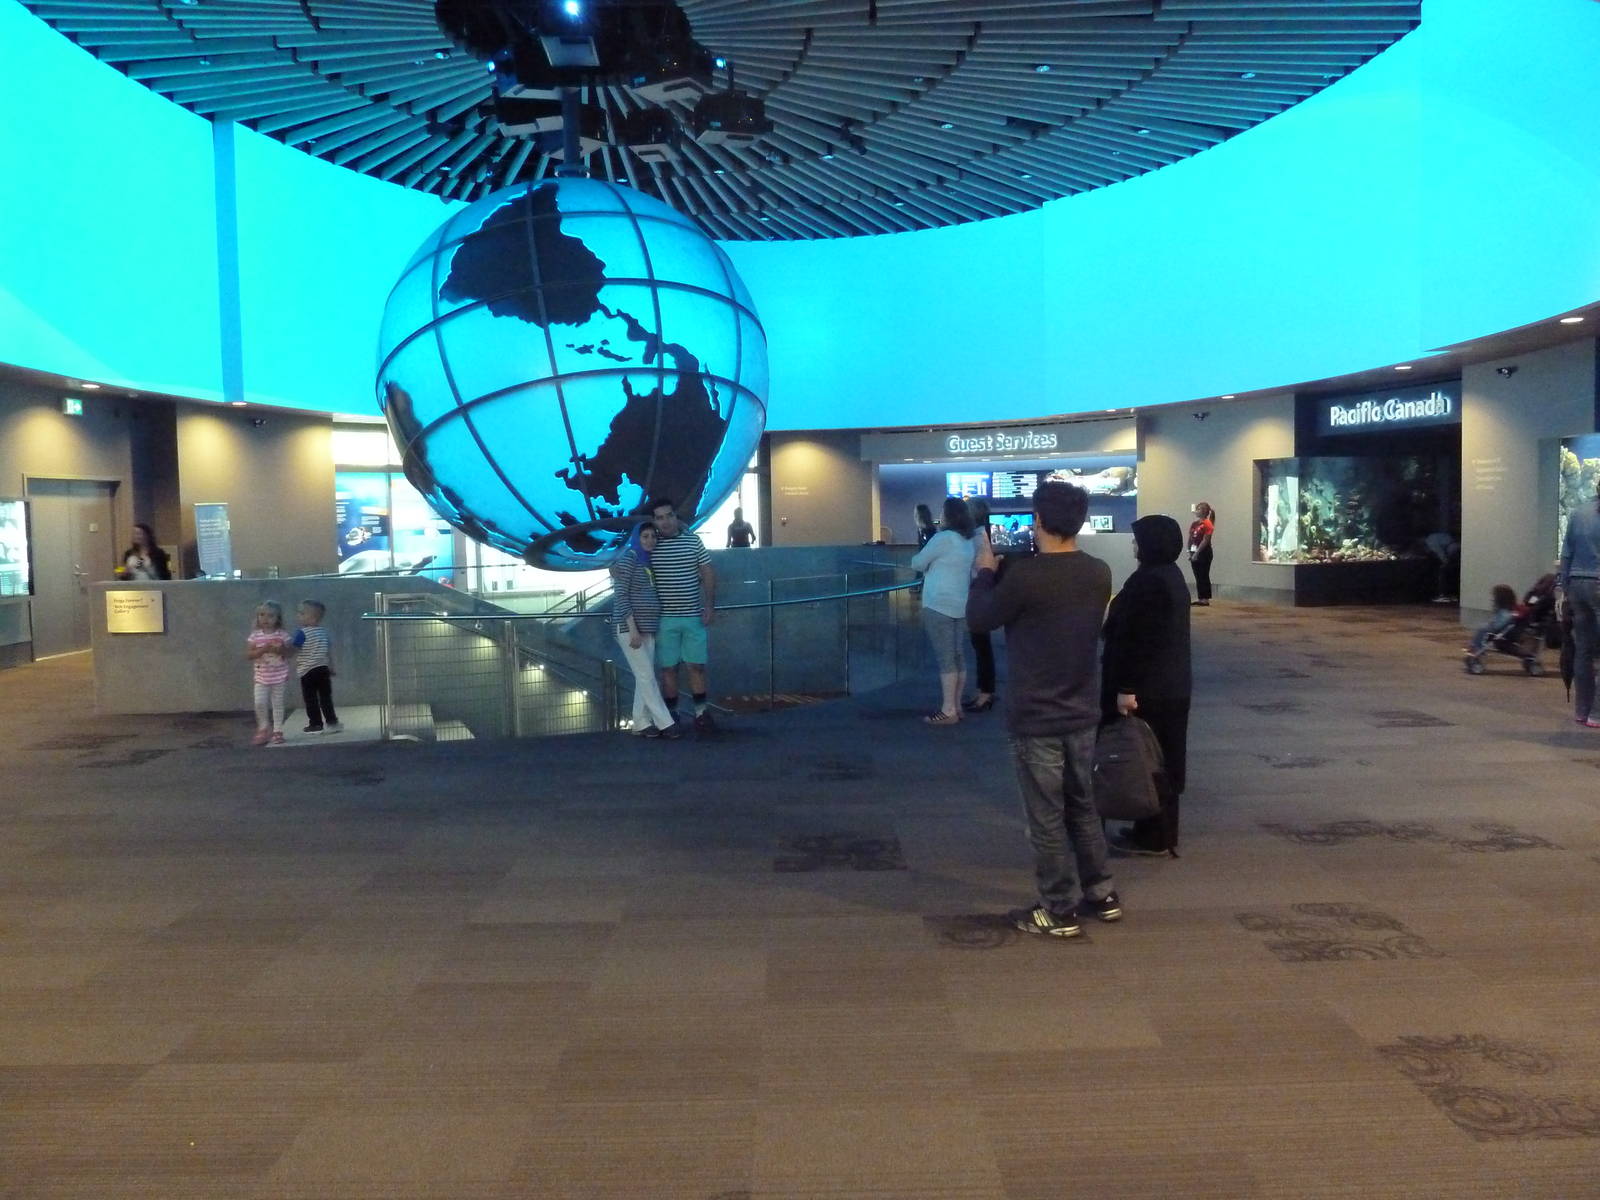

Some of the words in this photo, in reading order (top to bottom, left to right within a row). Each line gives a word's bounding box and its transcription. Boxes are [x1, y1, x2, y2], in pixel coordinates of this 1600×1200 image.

[1330, 400, 1382, 426] Pacific
[1384, 391, 1450, 419] Canada
[947, 435, 993, 453] Guest
[996, 431, 1057, 451] Services
